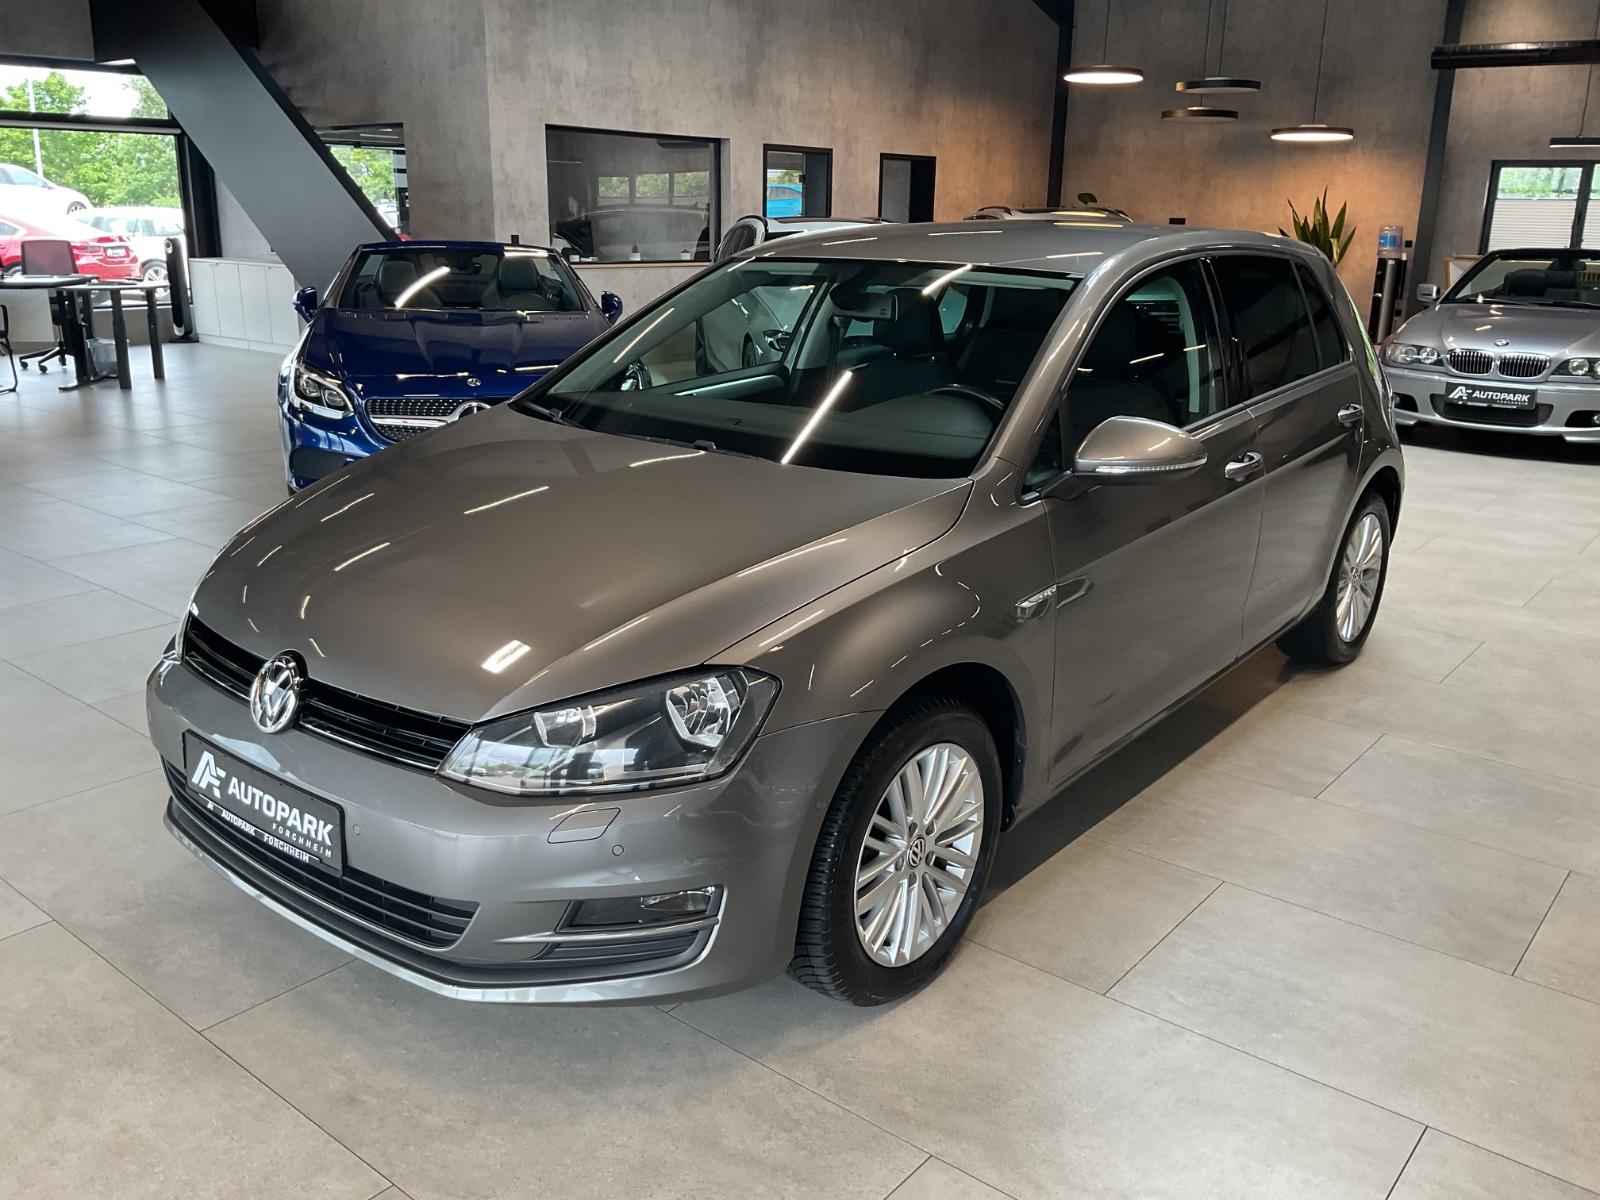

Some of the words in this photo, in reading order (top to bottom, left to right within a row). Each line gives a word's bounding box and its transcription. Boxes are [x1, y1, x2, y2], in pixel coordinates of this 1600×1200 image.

[1472, 390, 1531, 402] AUTOPARK
[228, 776, 335, 847] AUTOPARK
[221, 809, 256, 837] AUTOPARK
[263, 832, 310, 863] FORCHHEIM
[272, 822, 333, 858] FORCHHEIM
